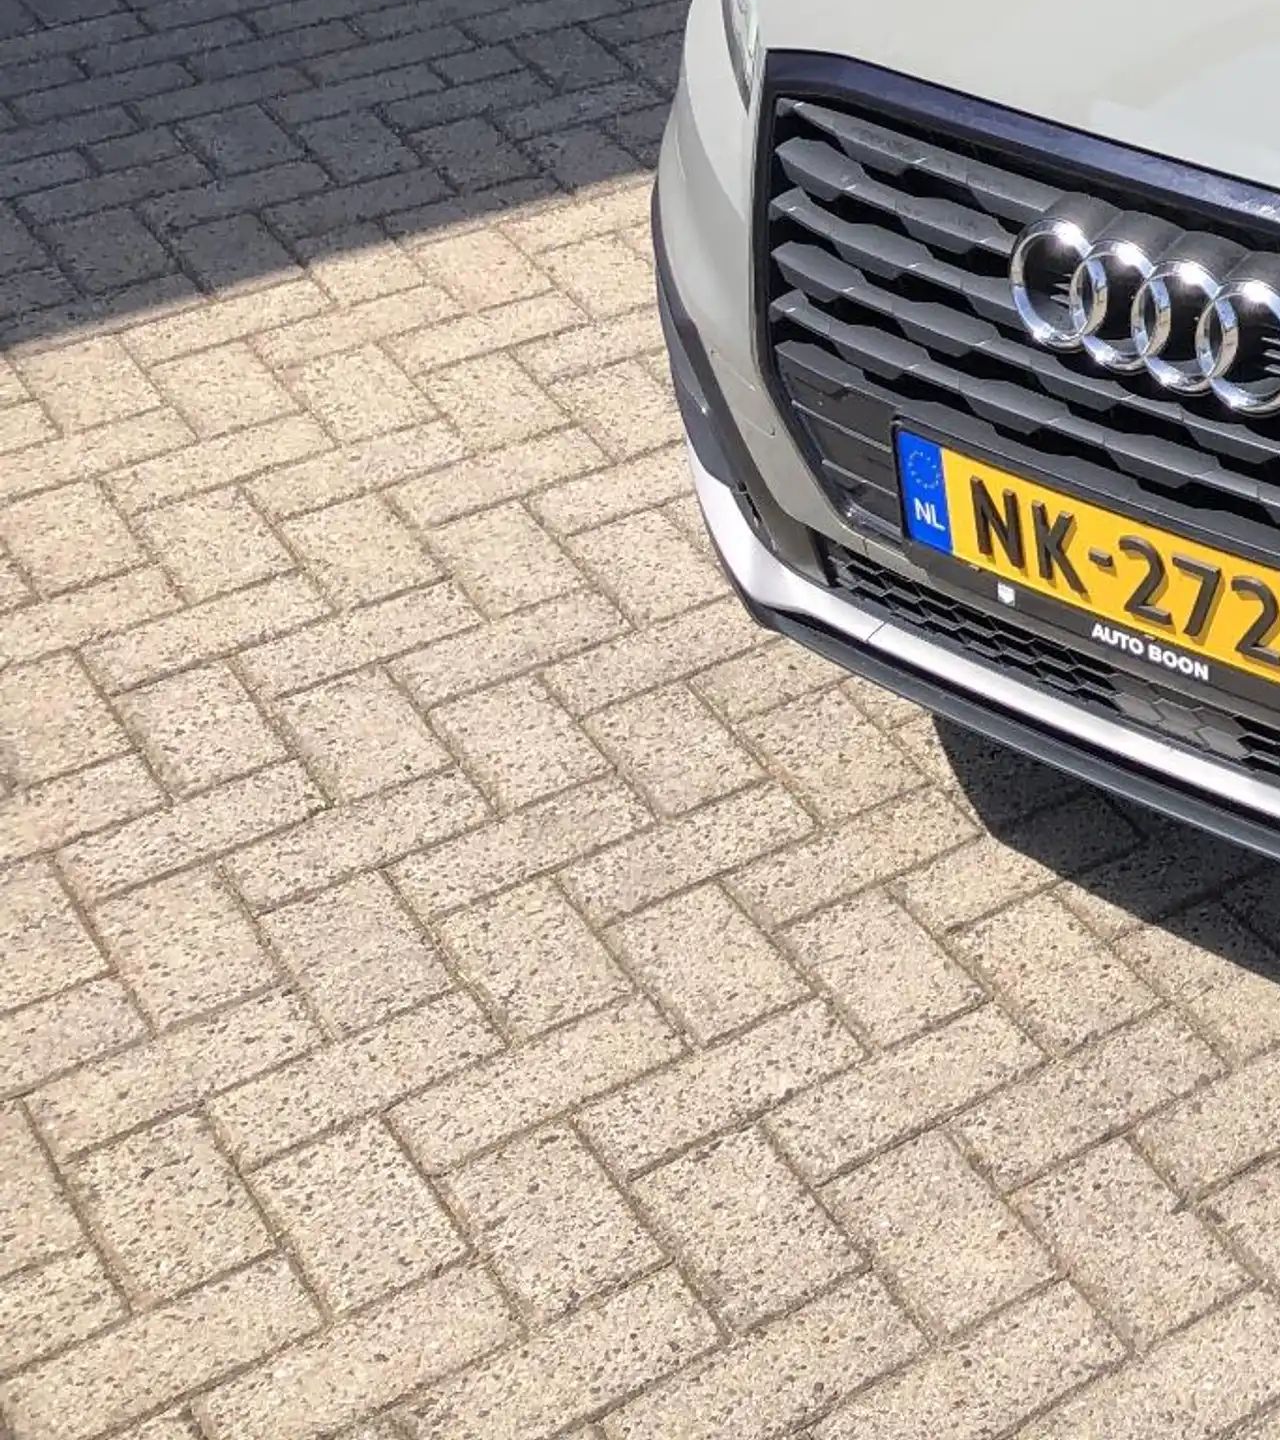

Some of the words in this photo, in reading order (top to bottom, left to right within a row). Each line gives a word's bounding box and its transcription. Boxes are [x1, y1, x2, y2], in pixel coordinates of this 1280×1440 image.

[914, 496, 947, 532] NL
[1091, 622, 1144, 656] AUTO
[1147, 643, 1210, 682] BOON
